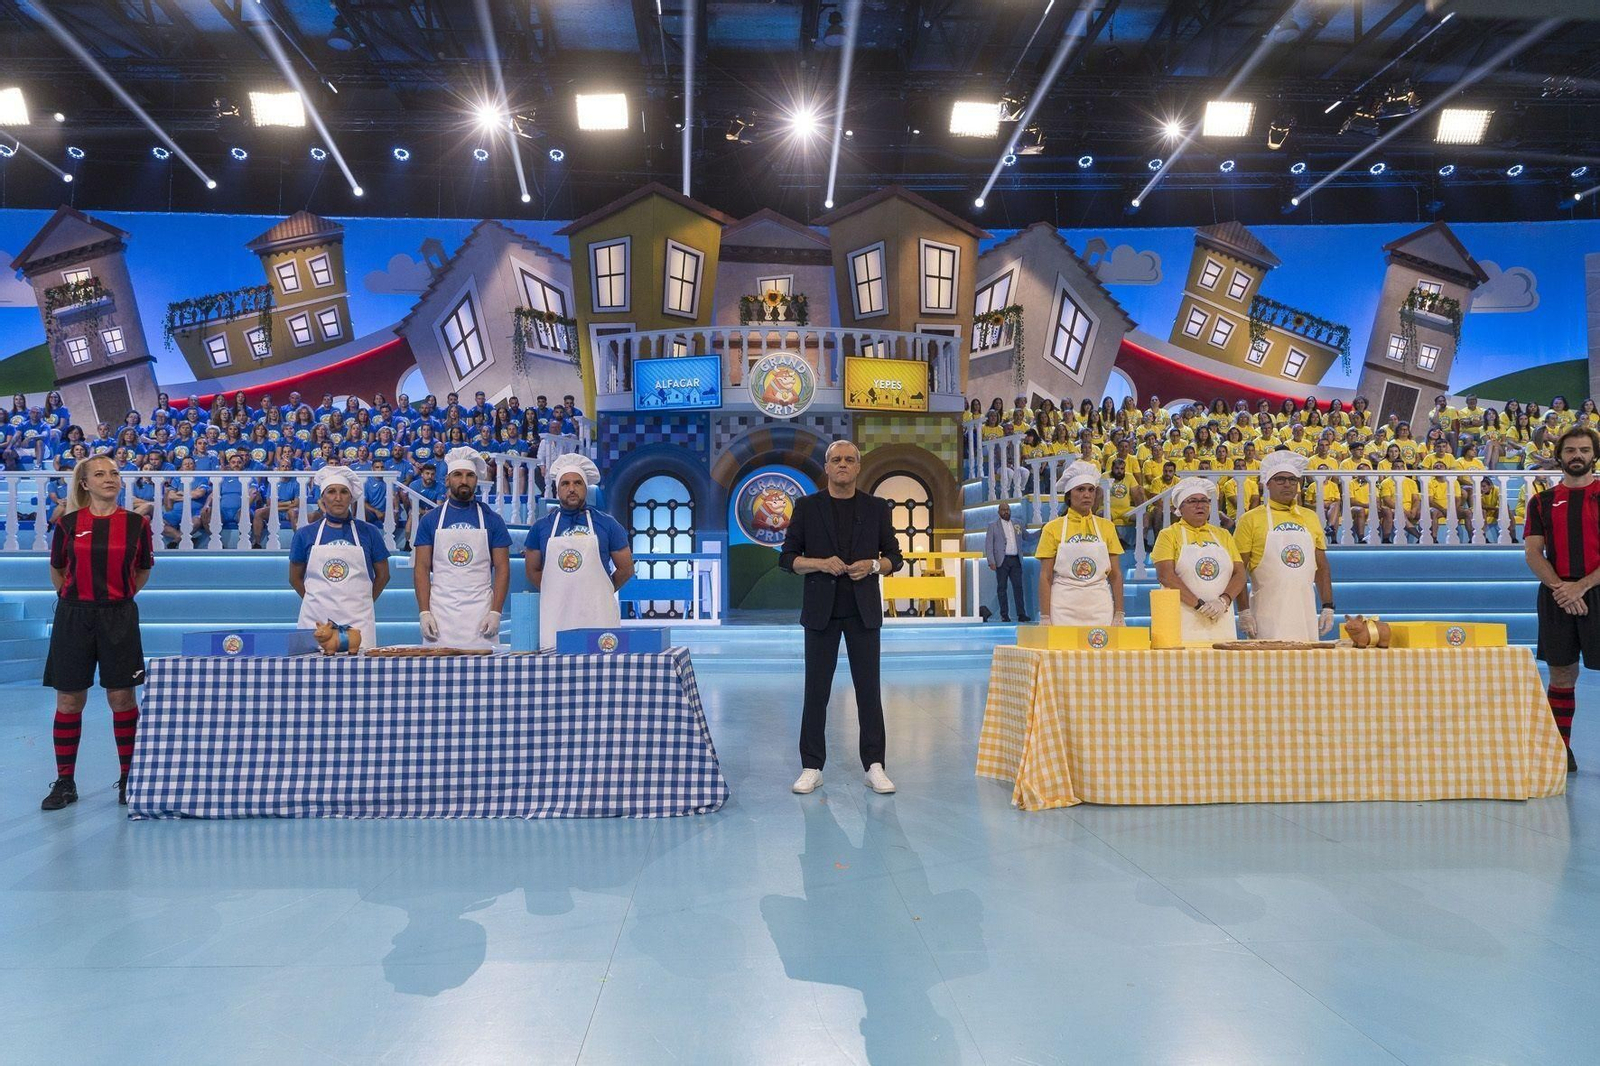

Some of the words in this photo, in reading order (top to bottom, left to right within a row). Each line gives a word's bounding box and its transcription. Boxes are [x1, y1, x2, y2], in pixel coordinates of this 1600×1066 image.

[760, 355, 806, 373] GRAND
[655, 378, 700, 389] ALFACAR
[874, 379, 902, 390] YEPES
[766, 402, 798, 415] PRIX
[749, 478, 797, 495] GRAND
